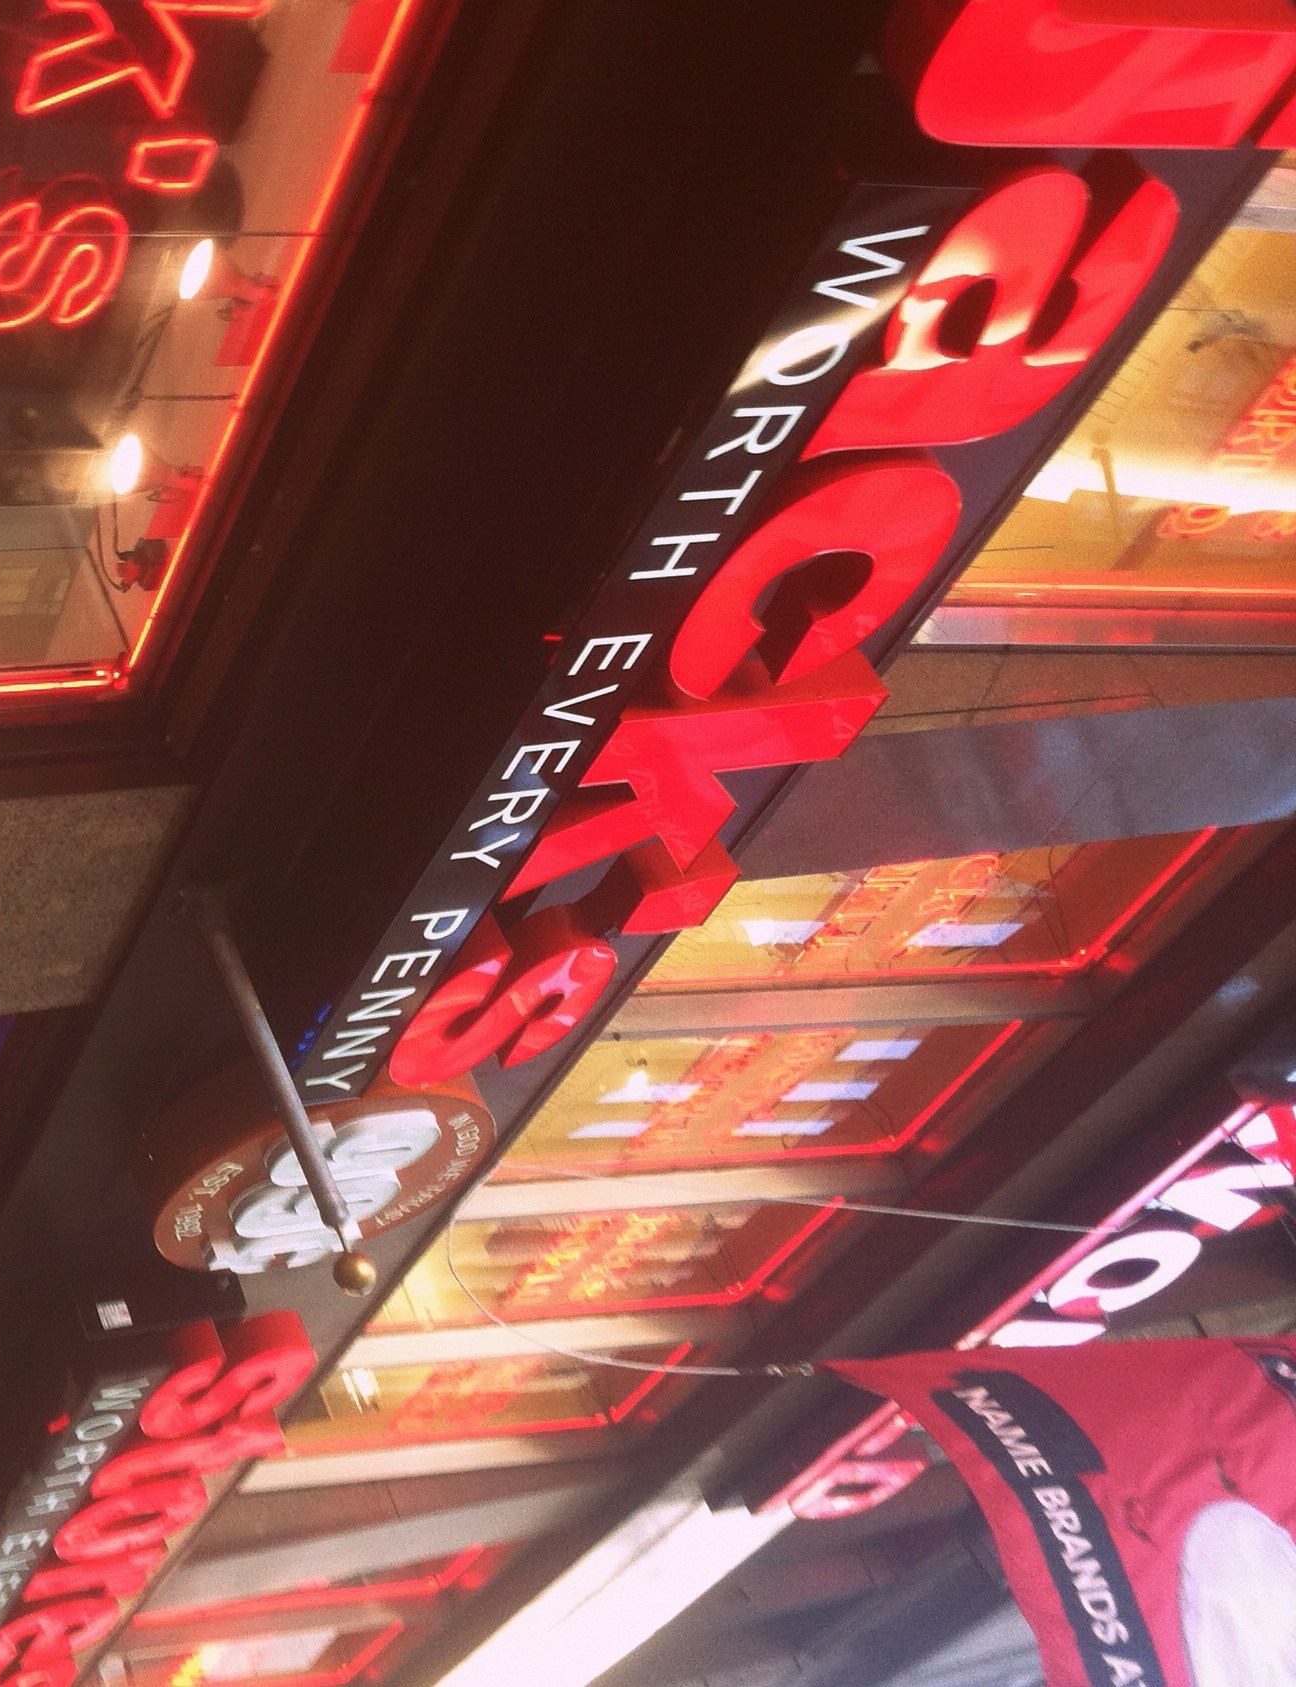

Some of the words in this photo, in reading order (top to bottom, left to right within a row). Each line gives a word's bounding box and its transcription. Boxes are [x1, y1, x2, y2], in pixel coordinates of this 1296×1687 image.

[629, 225, 928, 582] WORTH
[451, 634, 652, 869] EVERY
[305, 908, 469, 1092] PENNY
[455, 1126, 480, 1157] GOD
[26, 1377, 150, 1518] WORTH
[952, 1386, 1053, 1478] NAME
[1032, 1484, 1130, 1645] BRANDS
